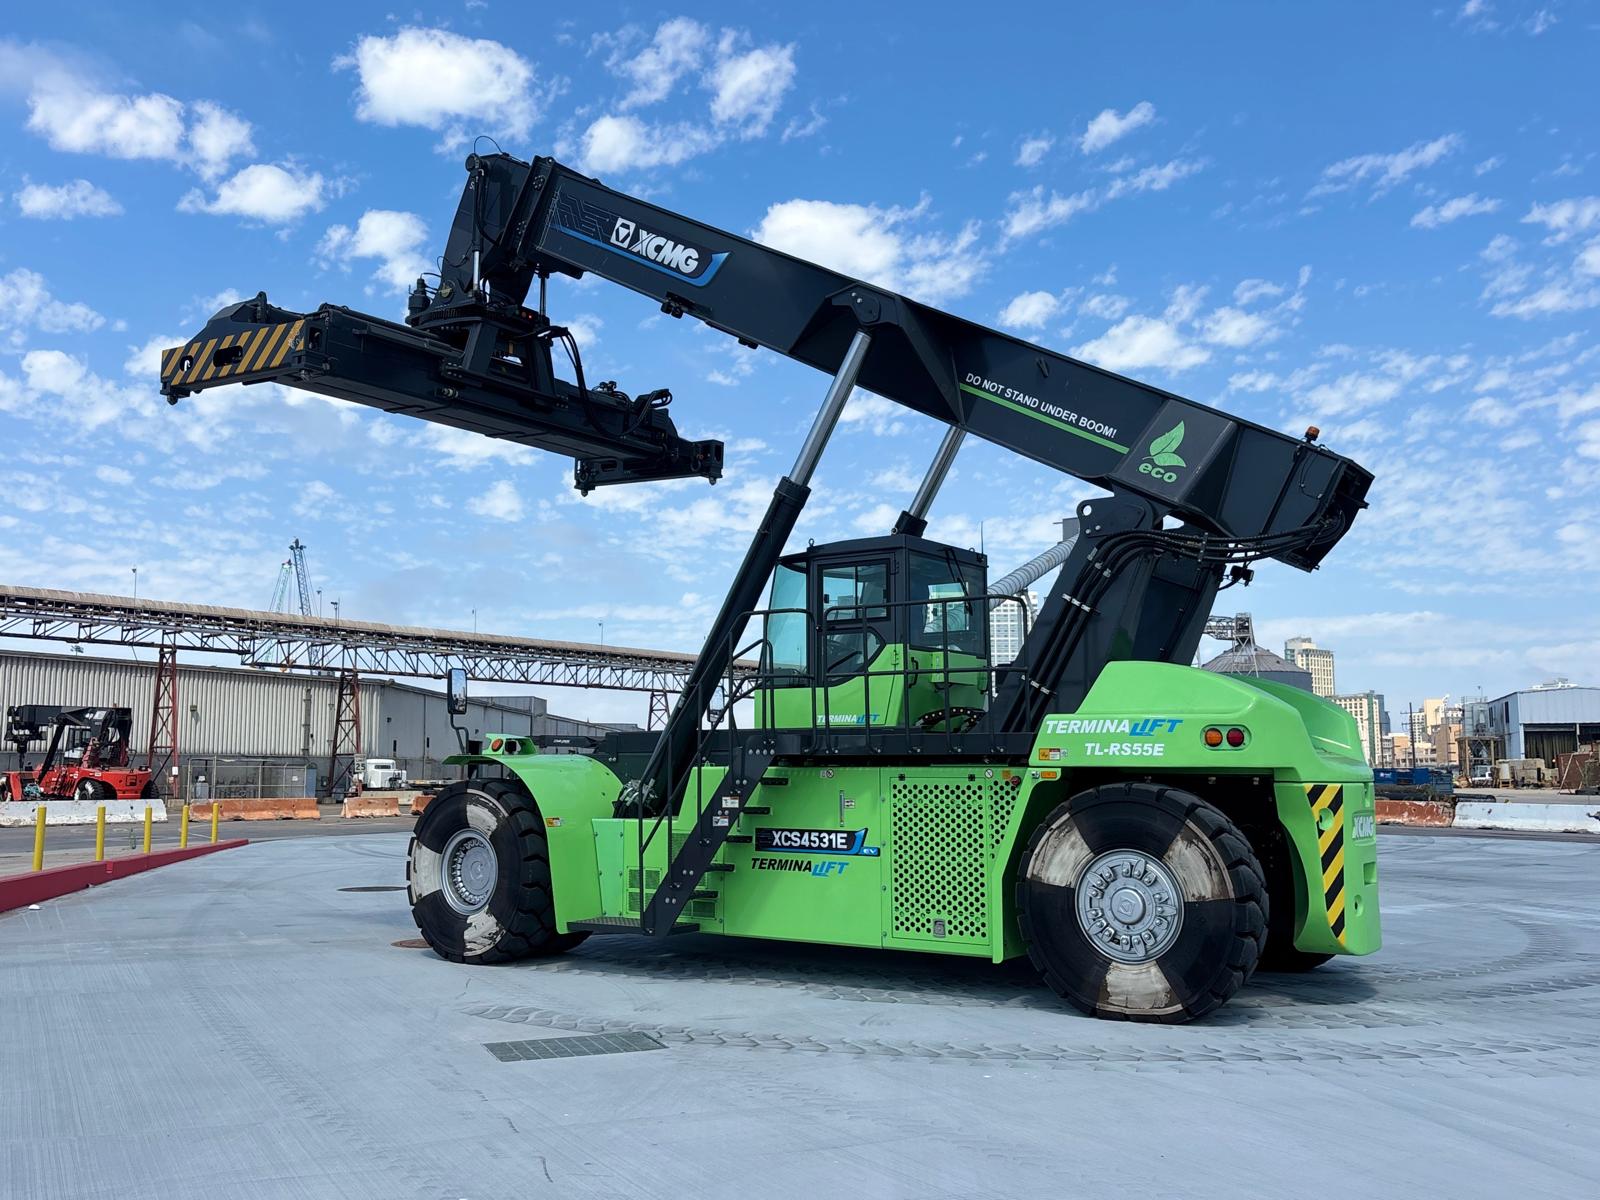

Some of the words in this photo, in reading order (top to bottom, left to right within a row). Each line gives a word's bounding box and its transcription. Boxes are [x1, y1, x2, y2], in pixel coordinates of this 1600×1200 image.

[629, 229, 698, 273] XCMG
[966, 373, 981, 385] DO
[982, 379, 1004, 394] NOT
[1005, 388, 1039, 408] STAND
[1040, 401, 1078, 423] UNDER
[1079, 416, 1117, 438] BOOM!
[1139, 462, 1177, 482] eco
[1085, 743, 1164, 756] TL-RS55E
[355, 763, 366, 771] 25
[772, 830, 848, 849] XCS4531E
